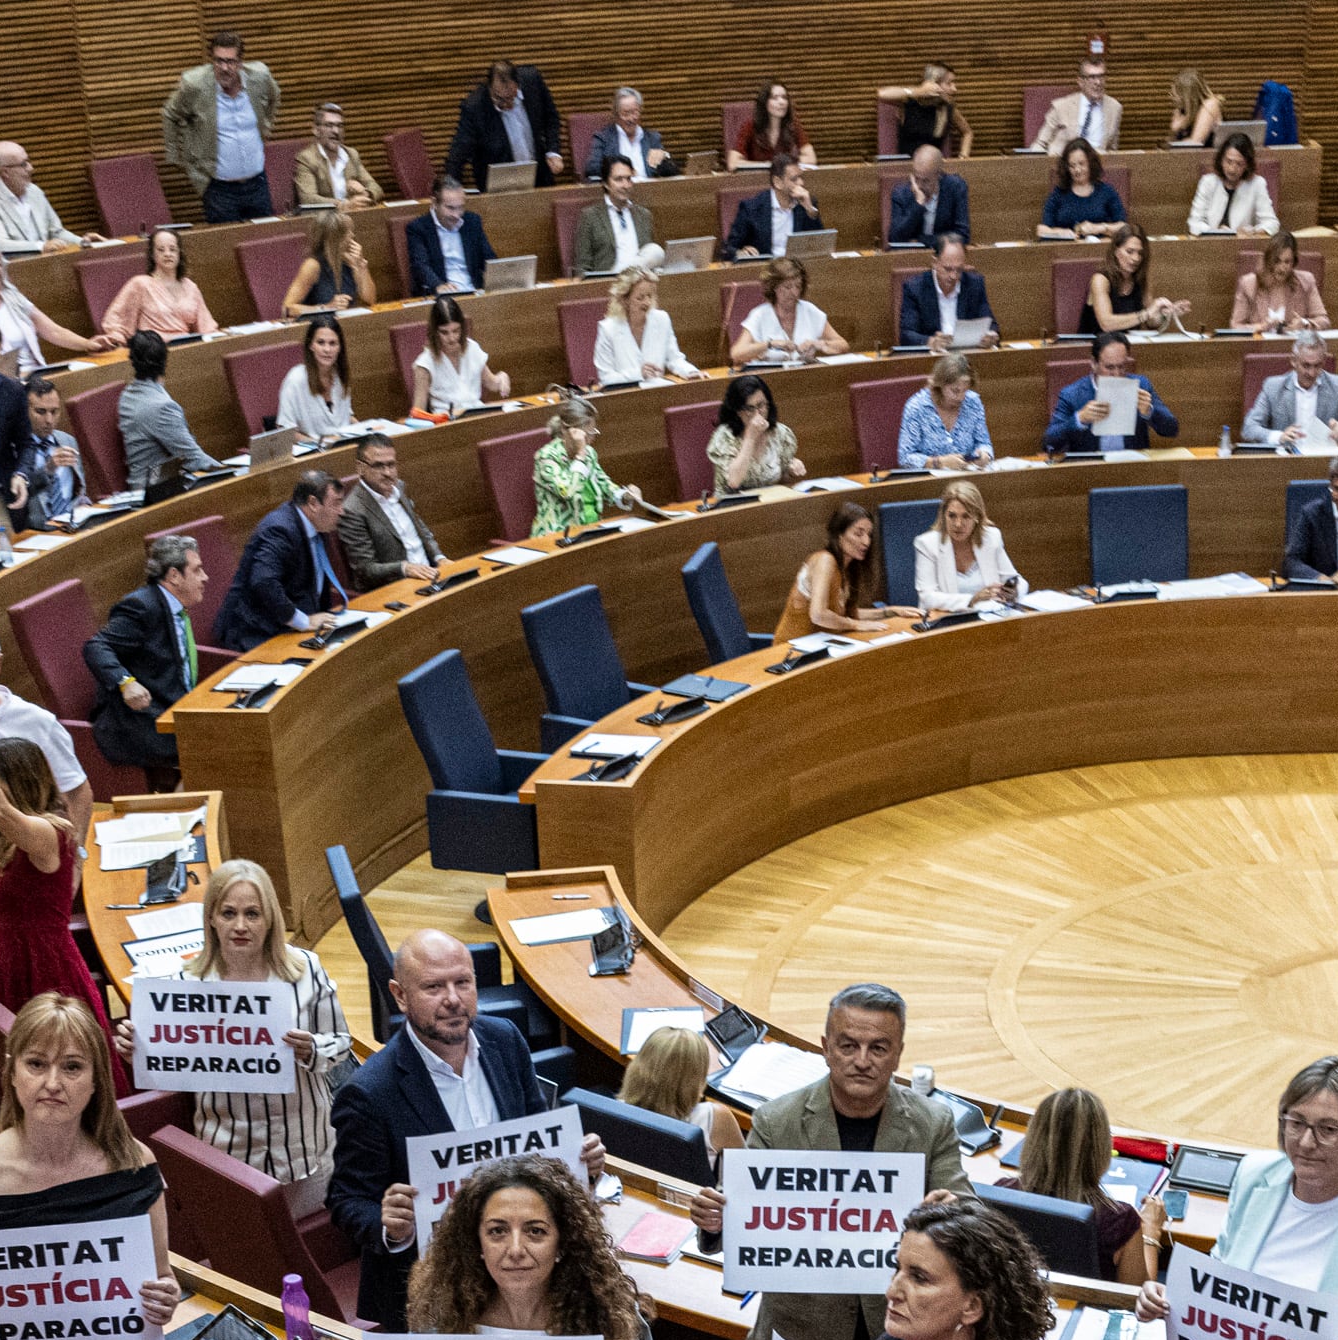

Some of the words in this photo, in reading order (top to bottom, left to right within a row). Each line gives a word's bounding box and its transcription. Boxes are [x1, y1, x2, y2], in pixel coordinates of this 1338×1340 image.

[150, 992, 270, 1014] VERITAT
[148, 1016, 275, 1046] JUSTÍCIA
[146, 1050, 281, 1075] REPARACIÓ
[430, 1125, 563, 1170] VERITAT
[748, 1167, 898, 1194] VERITAT
[745, 1199, 898, 1232] JUSTÍCIA
[1189, 1267, 1328, 1334] VERITAT
